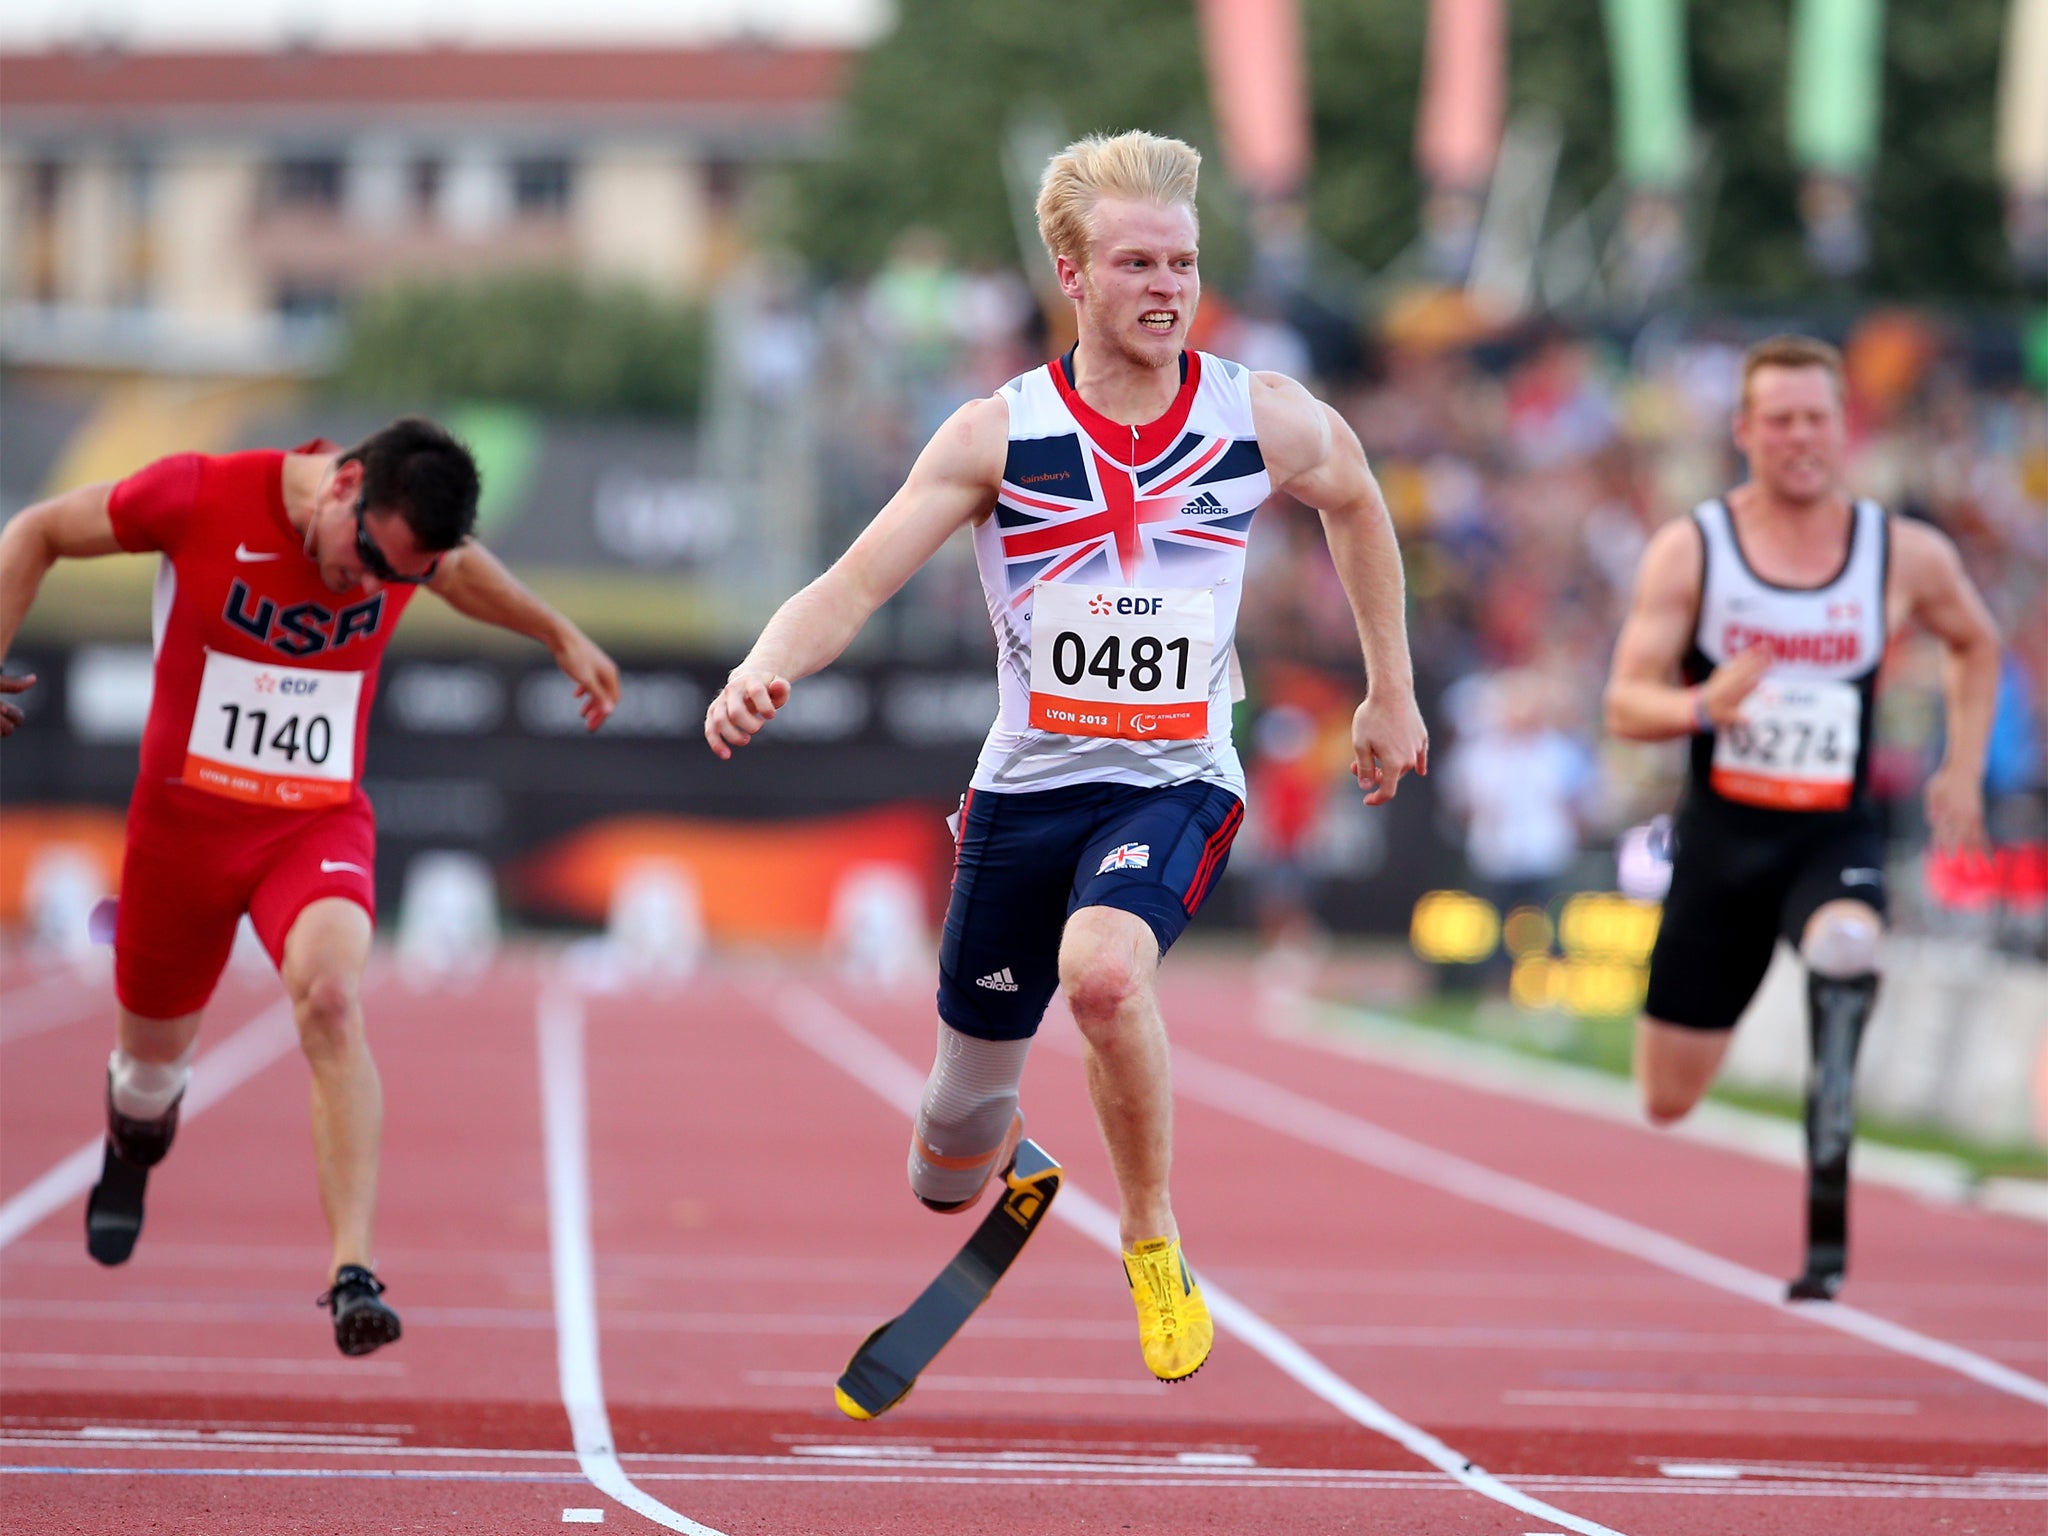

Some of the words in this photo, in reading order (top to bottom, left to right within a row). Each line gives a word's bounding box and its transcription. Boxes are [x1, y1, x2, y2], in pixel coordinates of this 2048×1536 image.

[1020, 470, 1070, 484] Sainsbury's
[1181, 505, 1229, 515] adidas
[221, 577, 387, 658] USA
[1052, 631, 1190, 692] 0481
[1046, 708, 1076, 722] LYON
[1079, 714, 1108, 726] 2013
[221, 703, 331, 764] 1140
[975, 976, 1019, 992] adidas
